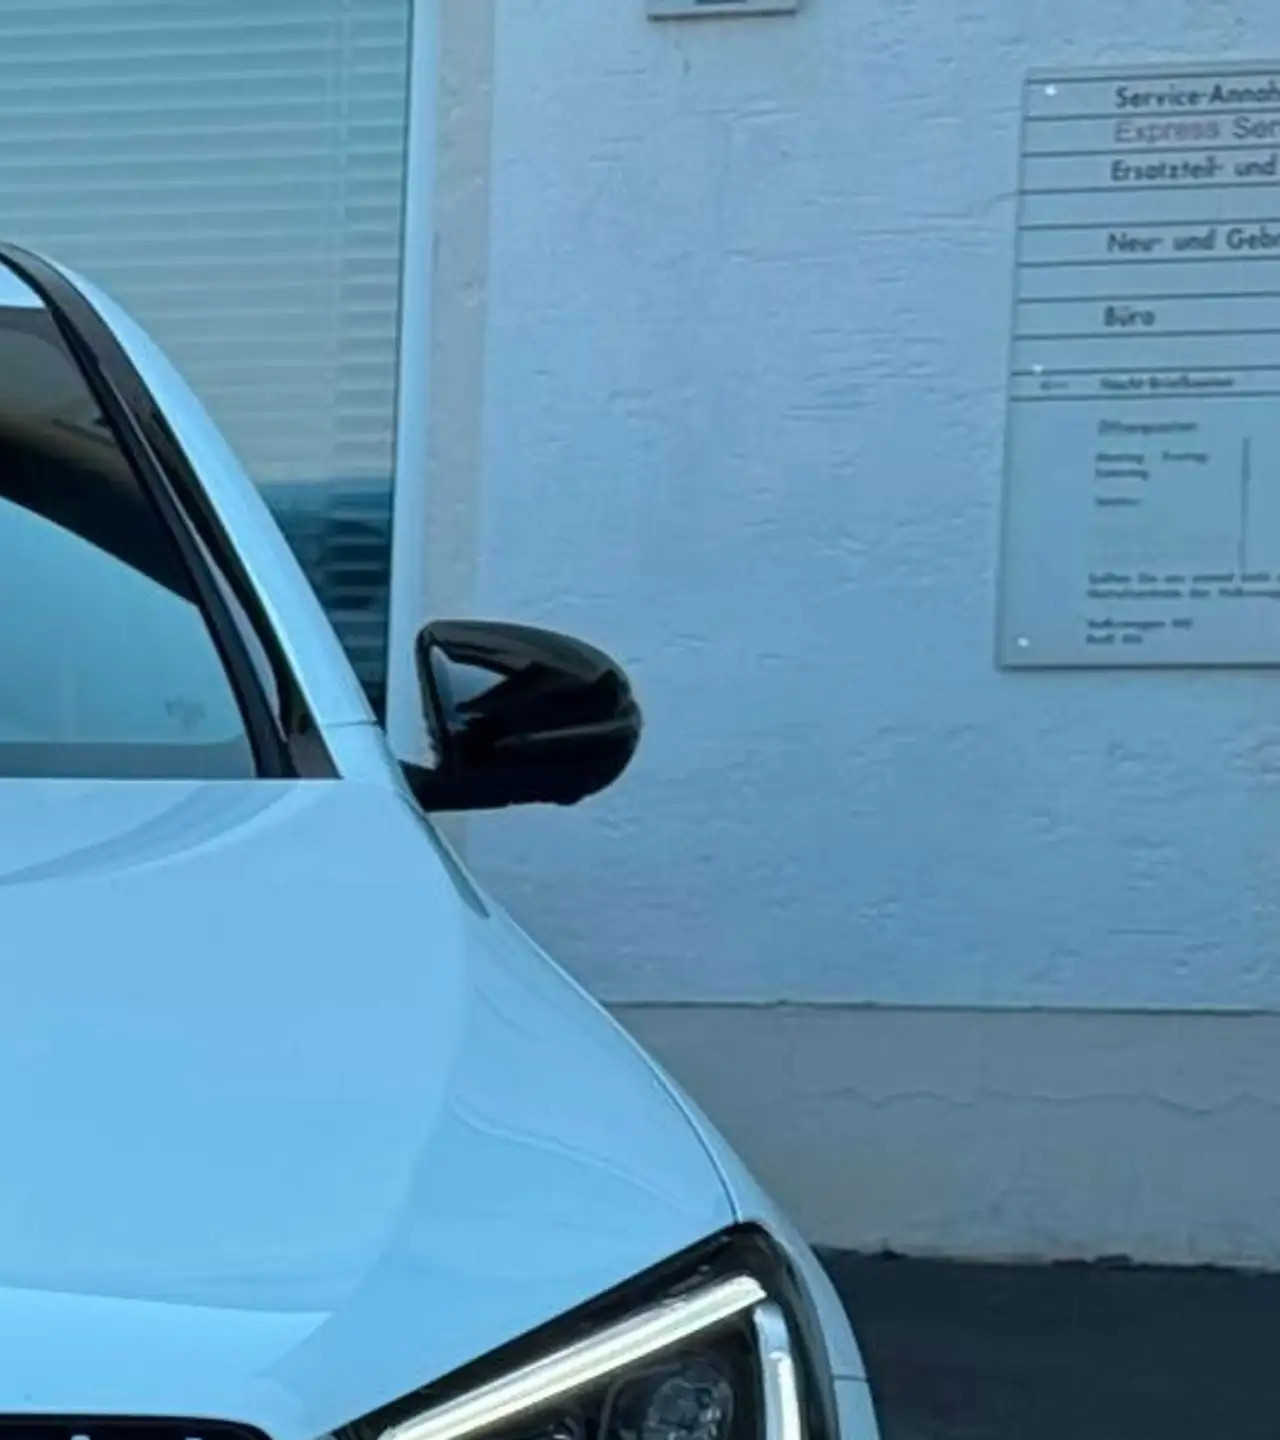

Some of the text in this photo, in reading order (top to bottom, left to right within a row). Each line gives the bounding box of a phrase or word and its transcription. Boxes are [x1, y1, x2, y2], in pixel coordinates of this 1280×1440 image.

[1114, 119, 1220, 144] Express
[1234, 152, 1278, 176] und
[1172, 228, 1217, 251] und
[1226, 225, 1280, 251] Geb
[1103, 304, 1157, 328] Büro
